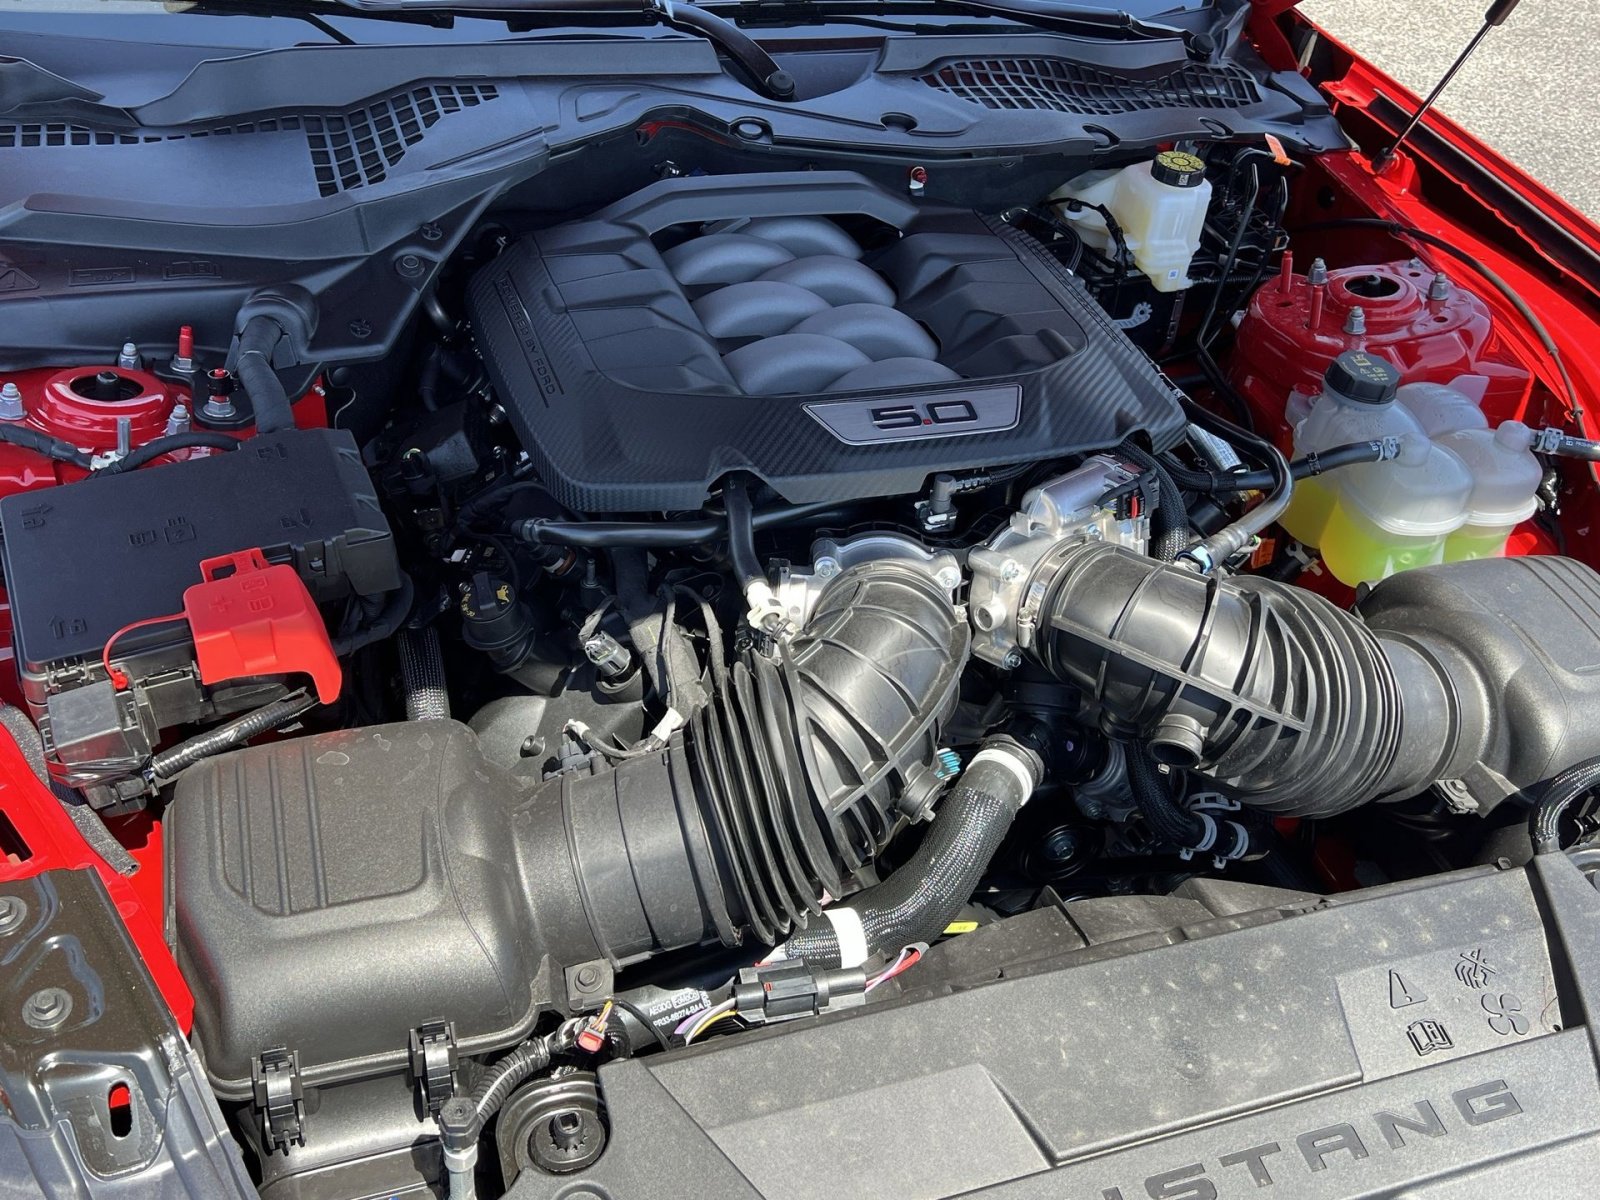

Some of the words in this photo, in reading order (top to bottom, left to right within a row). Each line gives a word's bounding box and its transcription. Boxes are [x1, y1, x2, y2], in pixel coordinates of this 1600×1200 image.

[500, 278, 529, 336] POWERED
[525, 338, 538, 354] BY
[535, 359, 556, 395] FORD
[870, 400, 979, 430] 5.0
[1102, 1080, 1524, 1200] STANG
